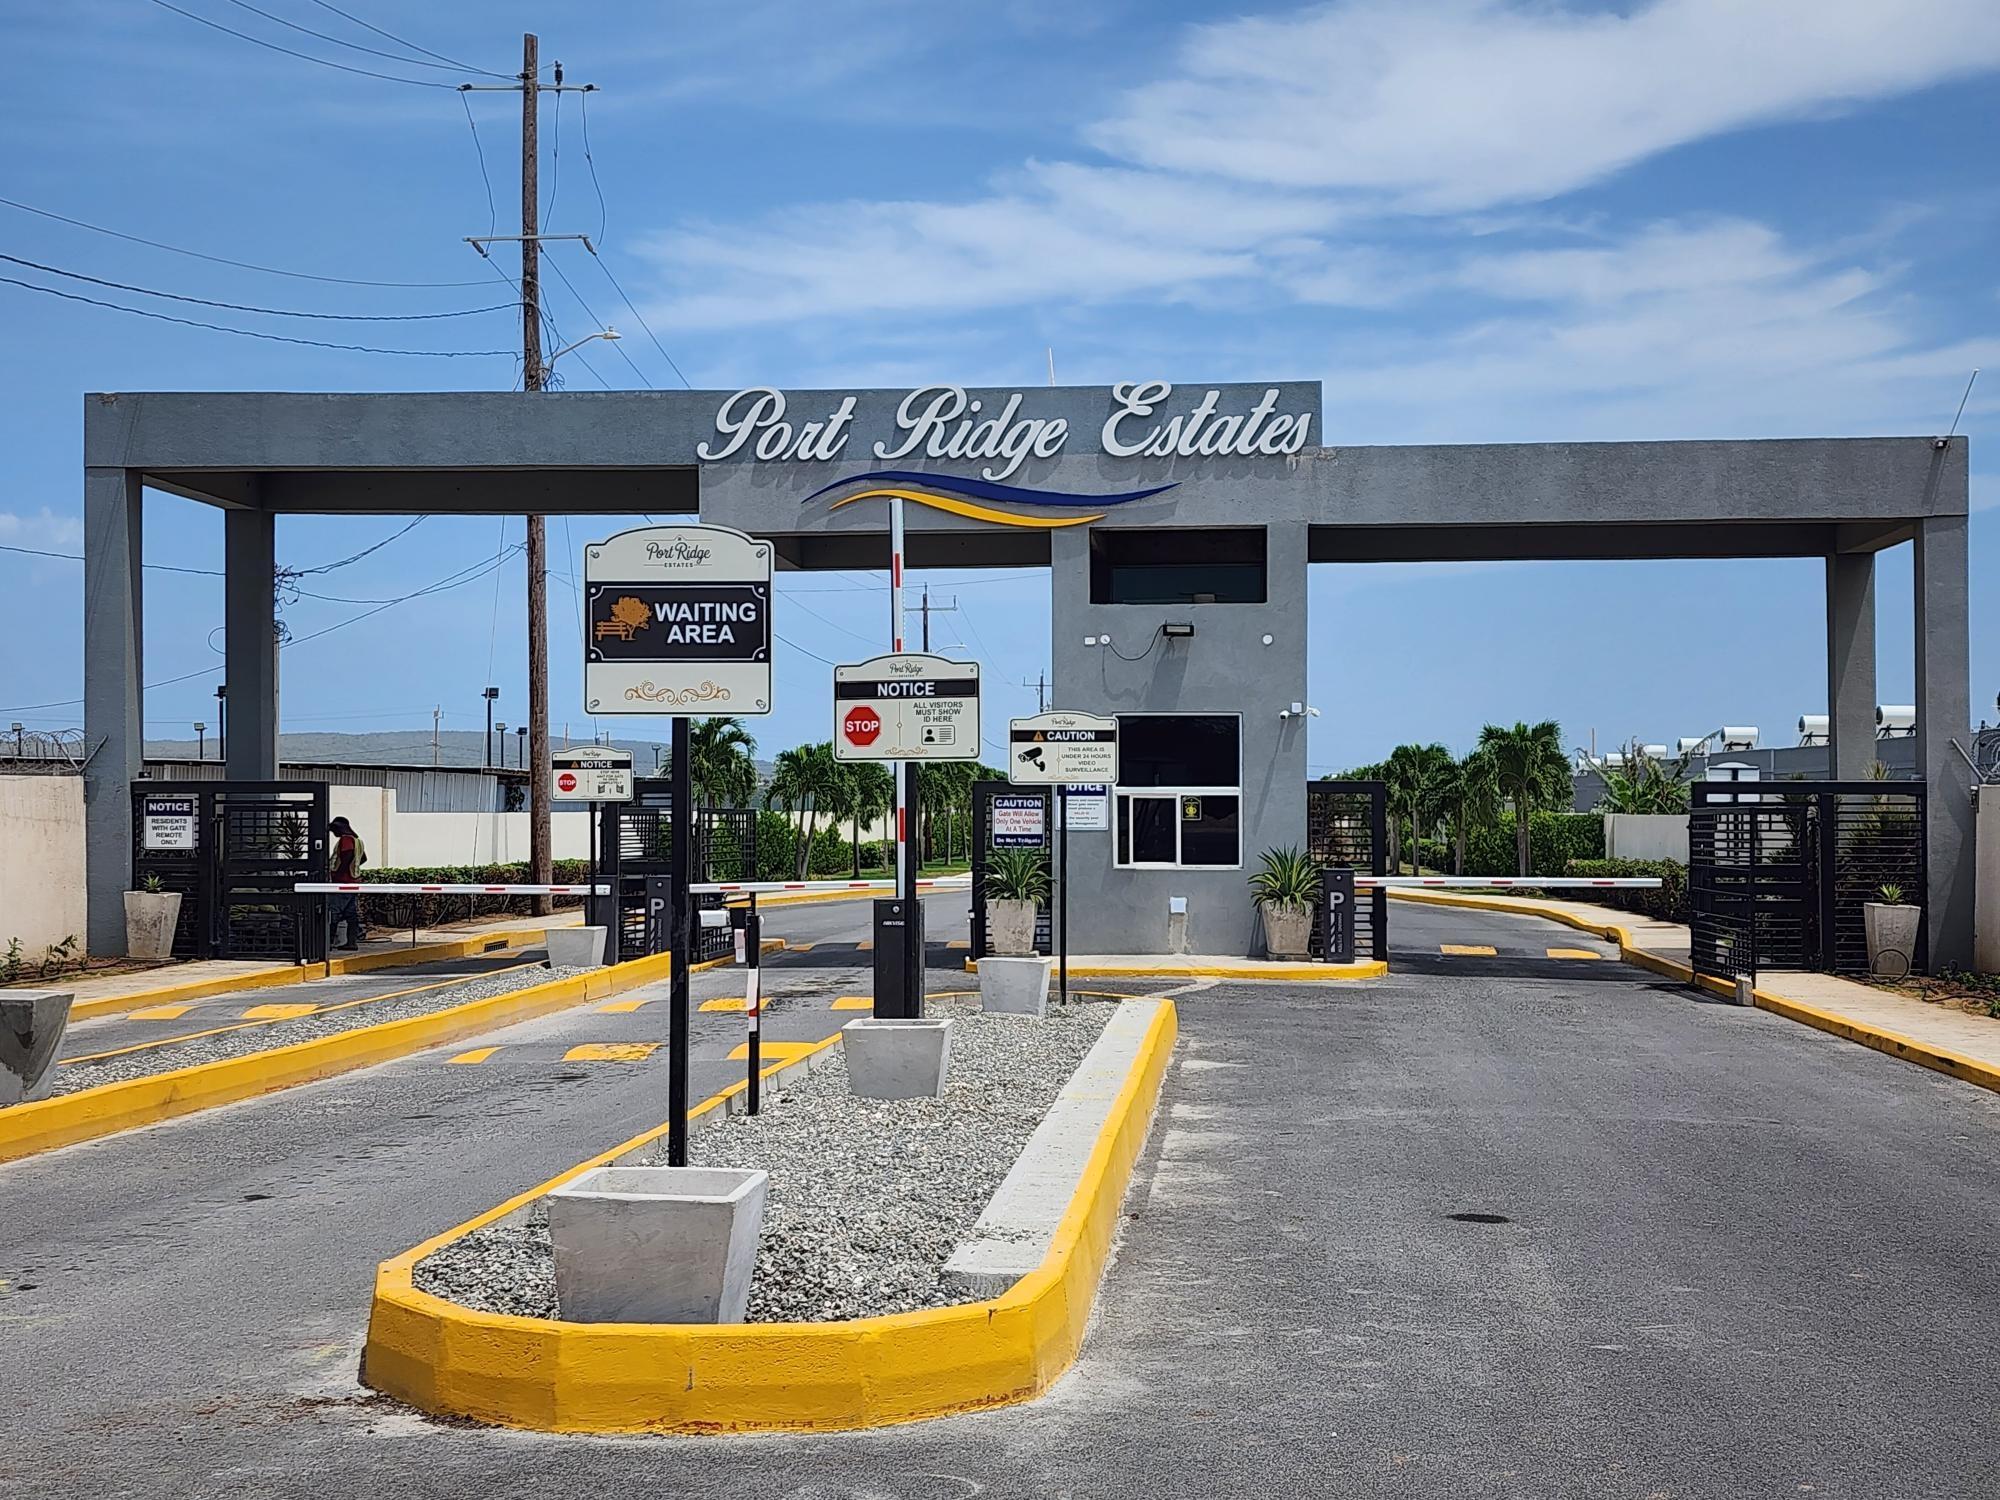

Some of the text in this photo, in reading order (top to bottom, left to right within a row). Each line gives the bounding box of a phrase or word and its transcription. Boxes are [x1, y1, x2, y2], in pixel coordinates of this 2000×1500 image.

[697, 381, 1313, 481] Port Ridge Estates
[646, 542, 711, 564] Port Ridge
[655, 603, 757, 622] WAITING
[667, 625, 735, 644] AREA
[889, 663, 924, 676] Port Ridge
[878, 682, 935, 696] NOTICE
[846, 720, 879, 732] STOP
[1047, 731, 1096, 740] CAUTION
[580, 760, 613, 768] NOTICE
[148, 802, 191, 811] NOTICE
[996, 800, 1042, 808] CAUTION
[650, 898, 665, 916] P
[1330, 892, 1345, 910] P
